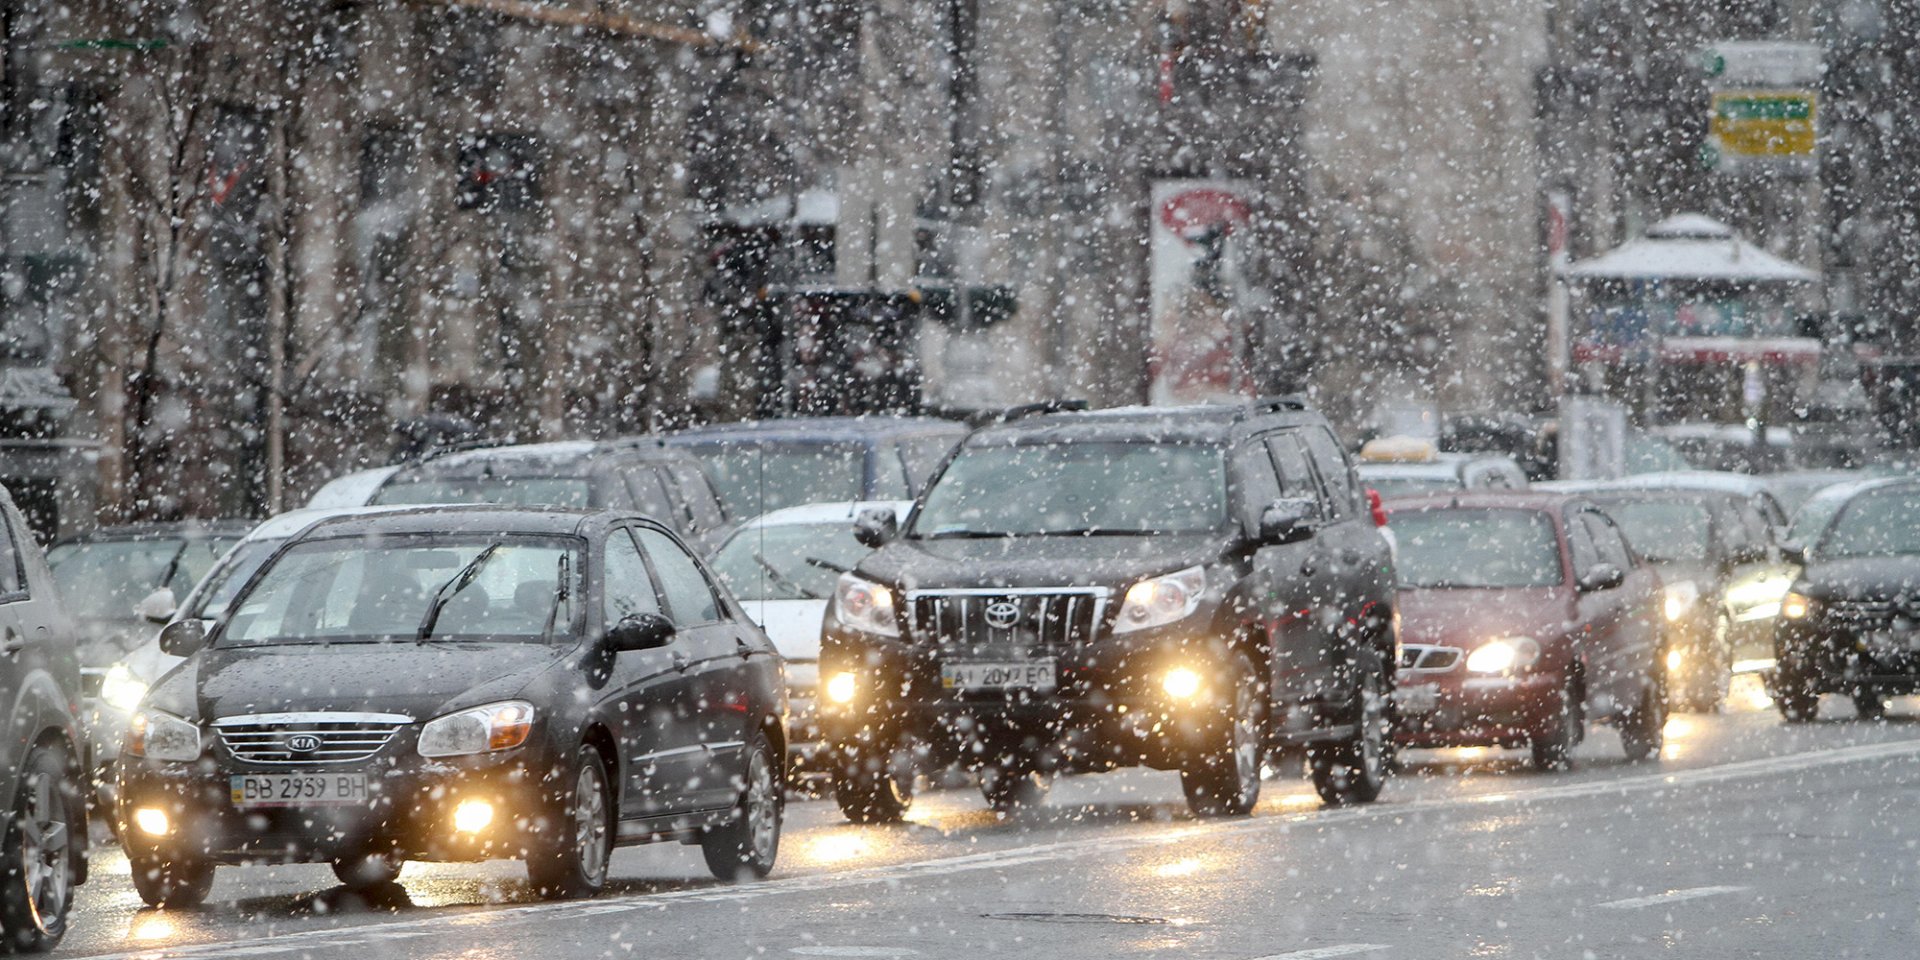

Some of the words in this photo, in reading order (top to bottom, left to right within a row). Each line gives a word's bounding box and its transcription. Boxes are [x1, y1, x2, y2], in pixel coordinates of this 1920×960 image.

[291, 738, 315, 748] KIA
[245, 778, 273, 799] BB
[280, 777, 326, 798] 2959
[337, 776, 366, 797] BH
